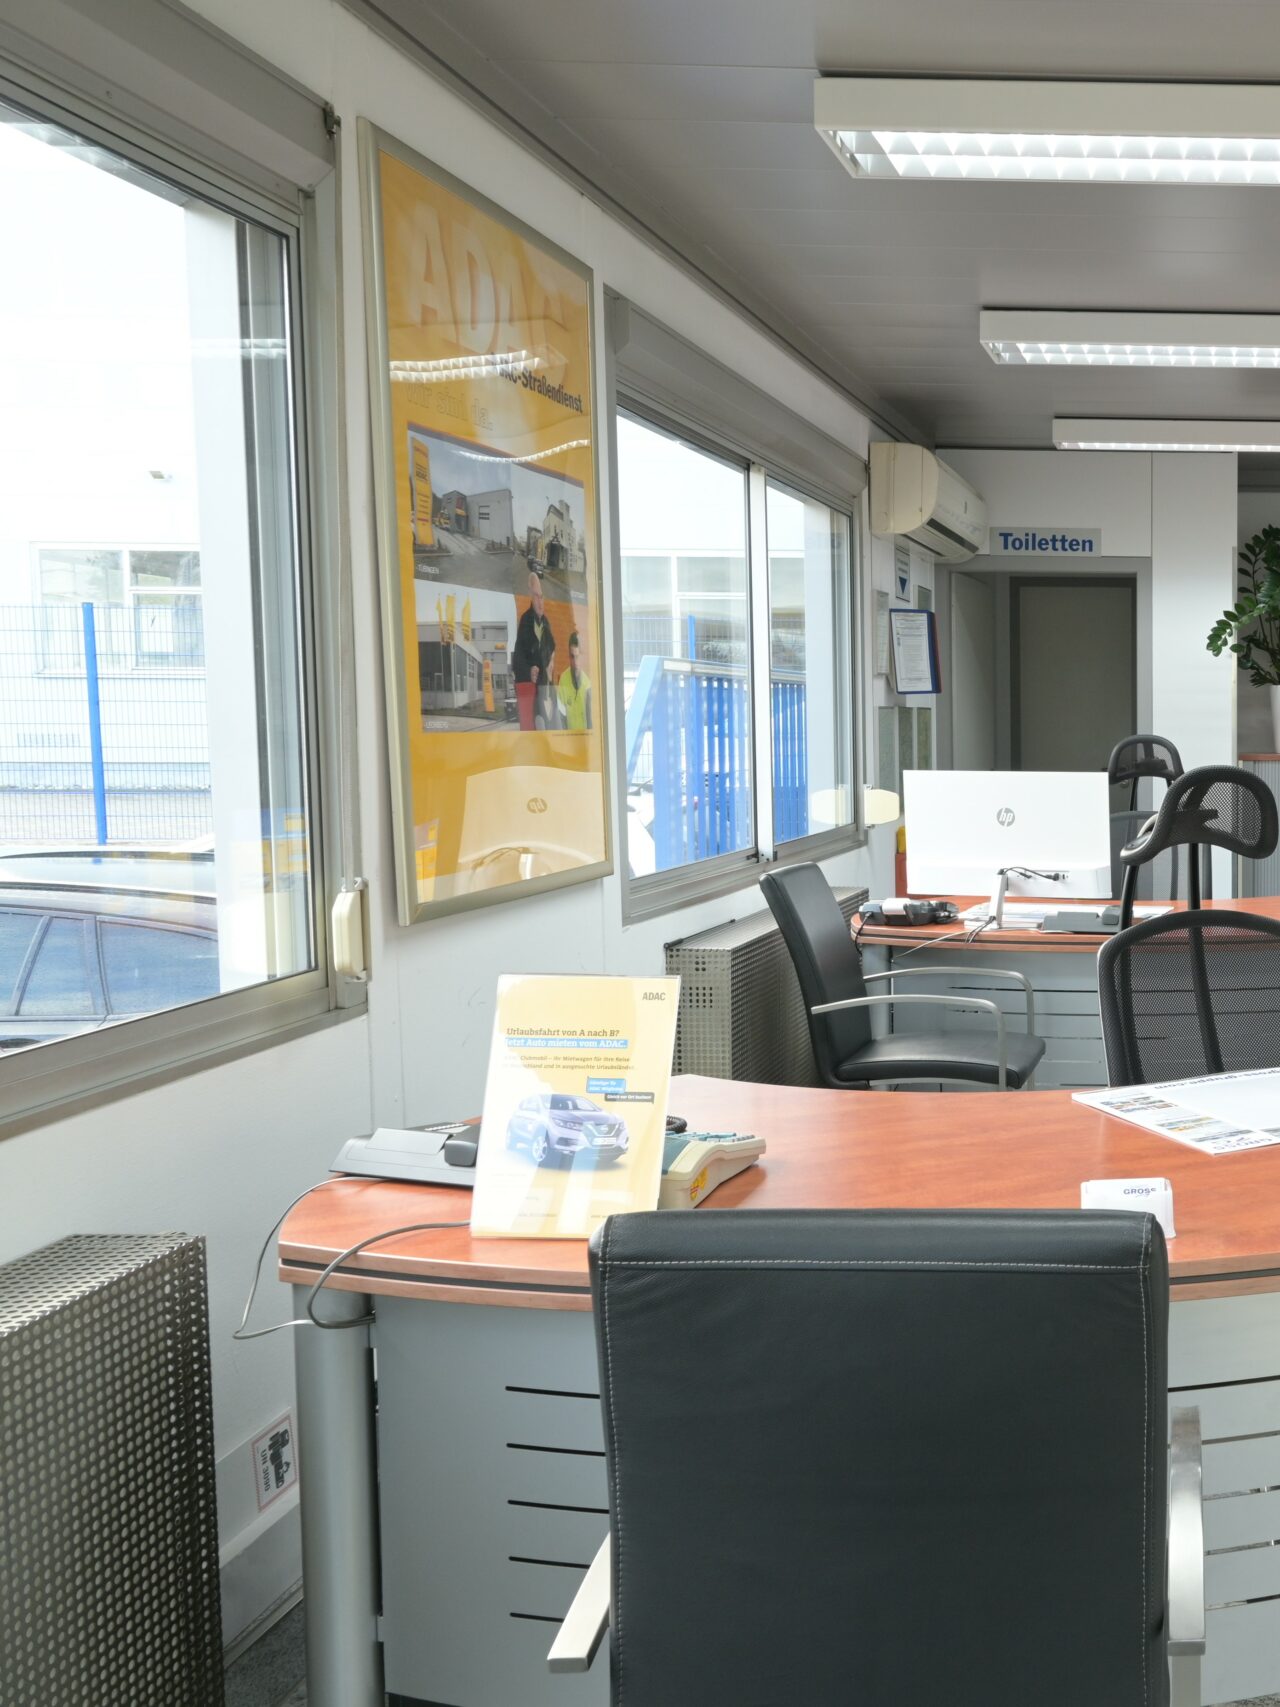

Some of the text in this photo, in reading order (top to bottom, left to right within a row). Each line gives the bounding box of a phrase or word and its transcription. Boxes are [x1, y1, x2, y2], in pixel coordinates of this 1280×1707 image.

[998, 532, 1094, 553] Toiletten
[997, 807, 1015, 827] hp
[642, 992, 666, 1001] ADAC
[506, 1028, 560, 1036] Urlaubsfahrt
[587, 1029, 607, 1037] nach
[609, 1029, 620, 1037] B?
[526, 1038, 547, 1047] Auto
[547, 1039, 578, 1047] mieten
[599, 1040, 627, 1048] ADAC.
[261, 1449, 268, 1465] UN
